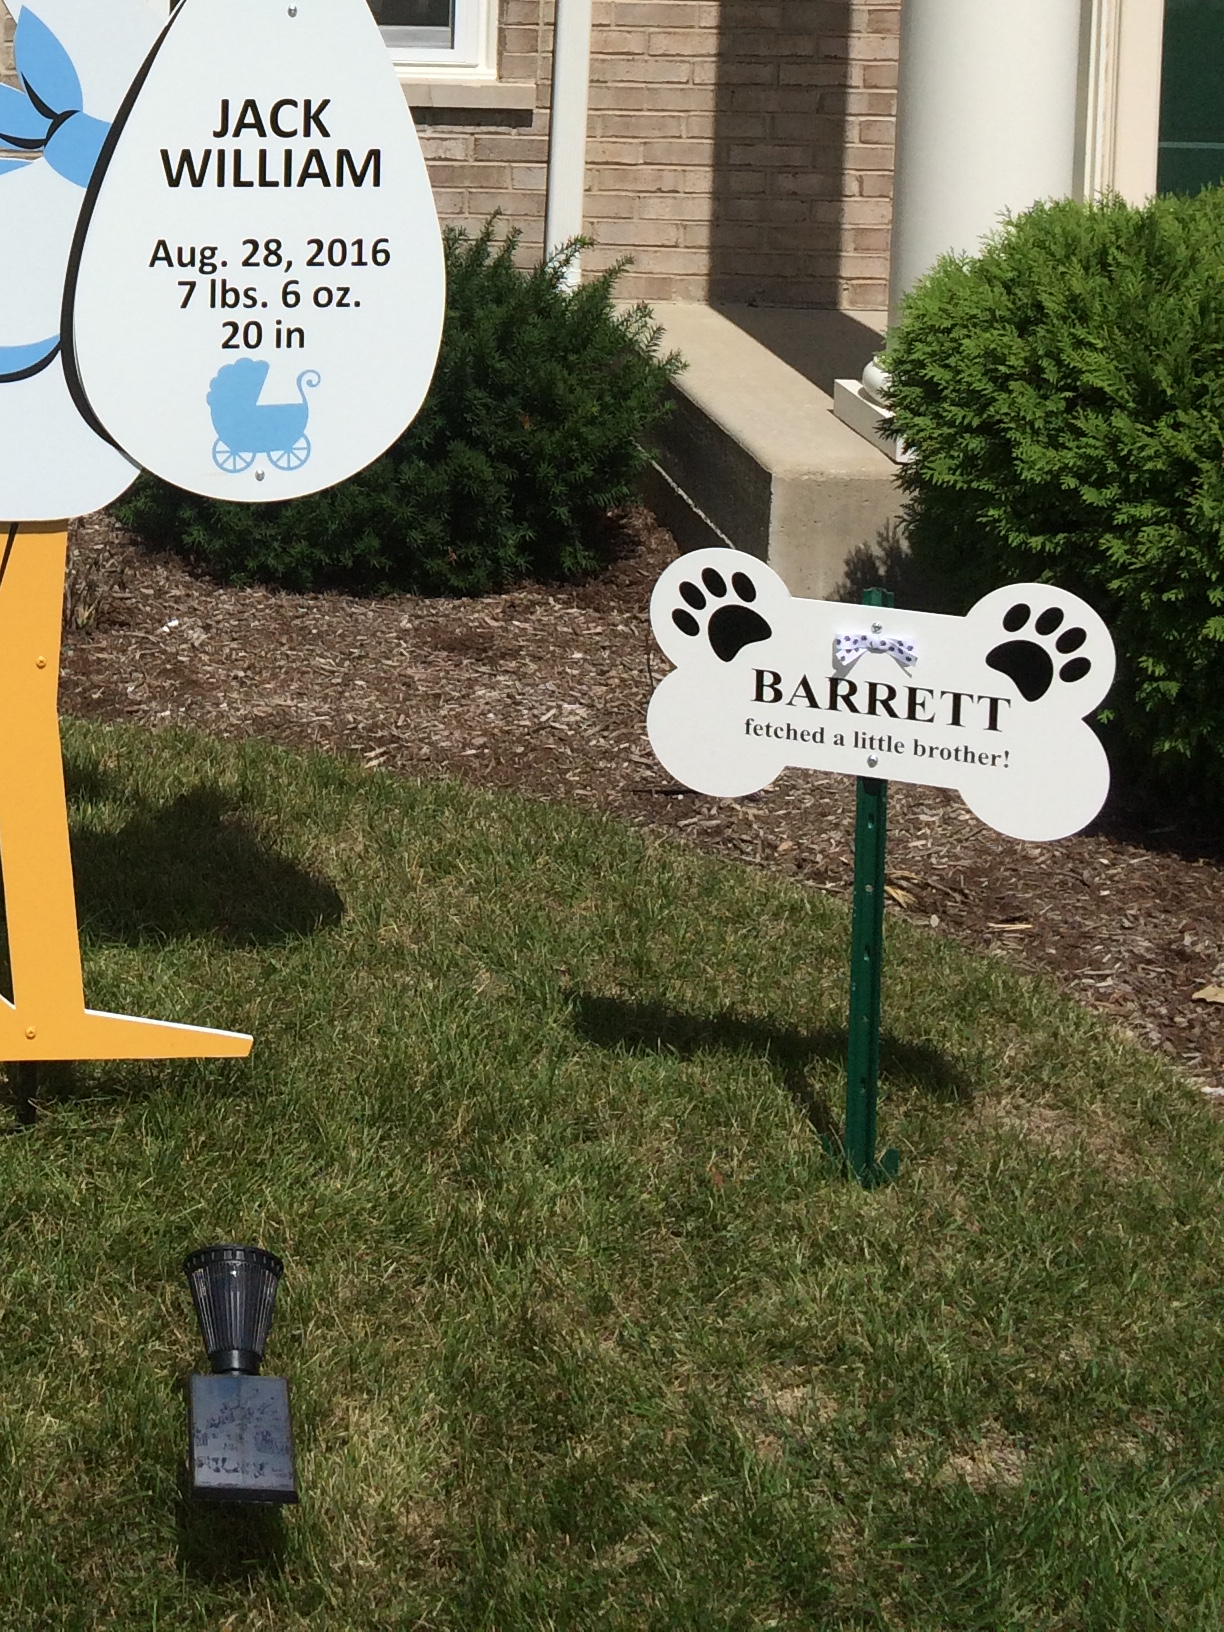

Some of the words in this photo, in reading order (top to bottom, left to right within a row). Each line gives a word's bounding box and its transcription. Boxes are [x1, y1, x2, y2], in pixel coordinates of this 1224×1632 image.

[212, 98, 331, 139] JACK
[159, 148, 381, 188] WILLIAM
[148, 239, 228, 275] Aug.
[241, 238, 293, 273] 28,
[306, 238, 391, 267] 2016
[177, 280, 197, 309] 7
[209, 278, 268, 309] lbs.
[281, 279, 301, 309] 6
[313, 286, 361, 308] oz.
[221, 320, 263, 350] 20
[275, 319, 305, 349] in
[752, 668, 1011, 732] BARRETT
[745, 718, 825, 744] fetched
[833, 733, 845, 747] a
[853, 731, 905, 754] little
[913, 738, 1010, 768] brother!
